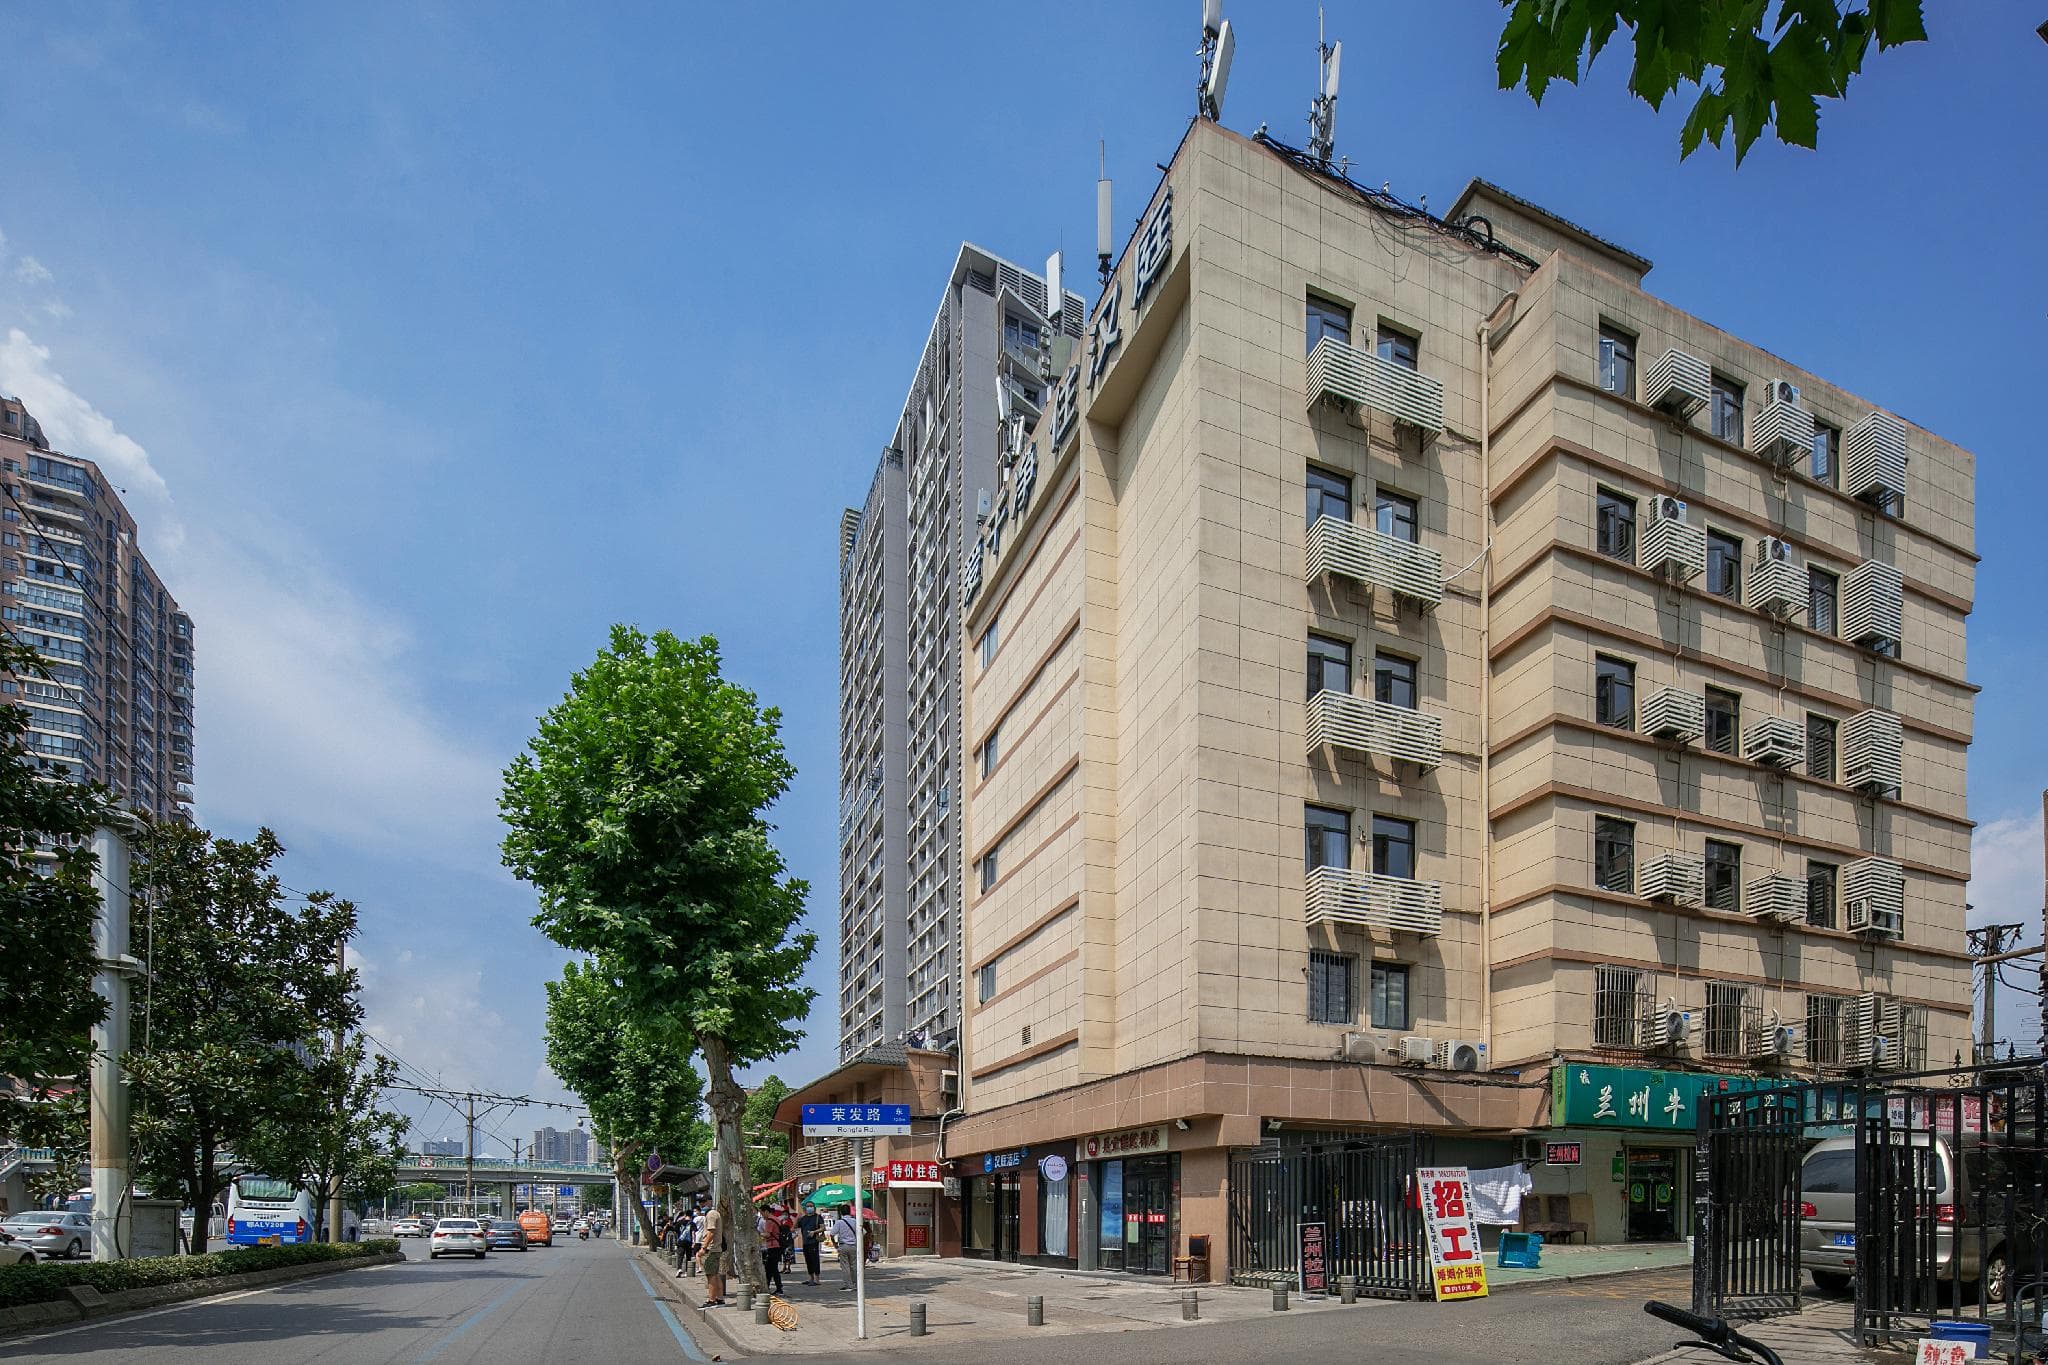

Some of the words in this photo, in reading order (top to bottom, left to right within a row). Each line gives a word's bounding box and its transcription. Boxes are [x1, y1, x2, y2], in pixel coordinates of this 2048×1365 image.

[831, 1107, 881, 1122] 荣发路
[837, 1126, 862, 1134] Rongfa
[994, 1152, 1021, 1169] 汉庭酒店
[891, 1163, 938, 1180] 特价住宿
[1432, 1180, 1472, 1261] 招工
[1303, 1226, 1325, 1289] 兰州拉面
[1437, 1265, 1482, 1281] 婚姻介绍所
